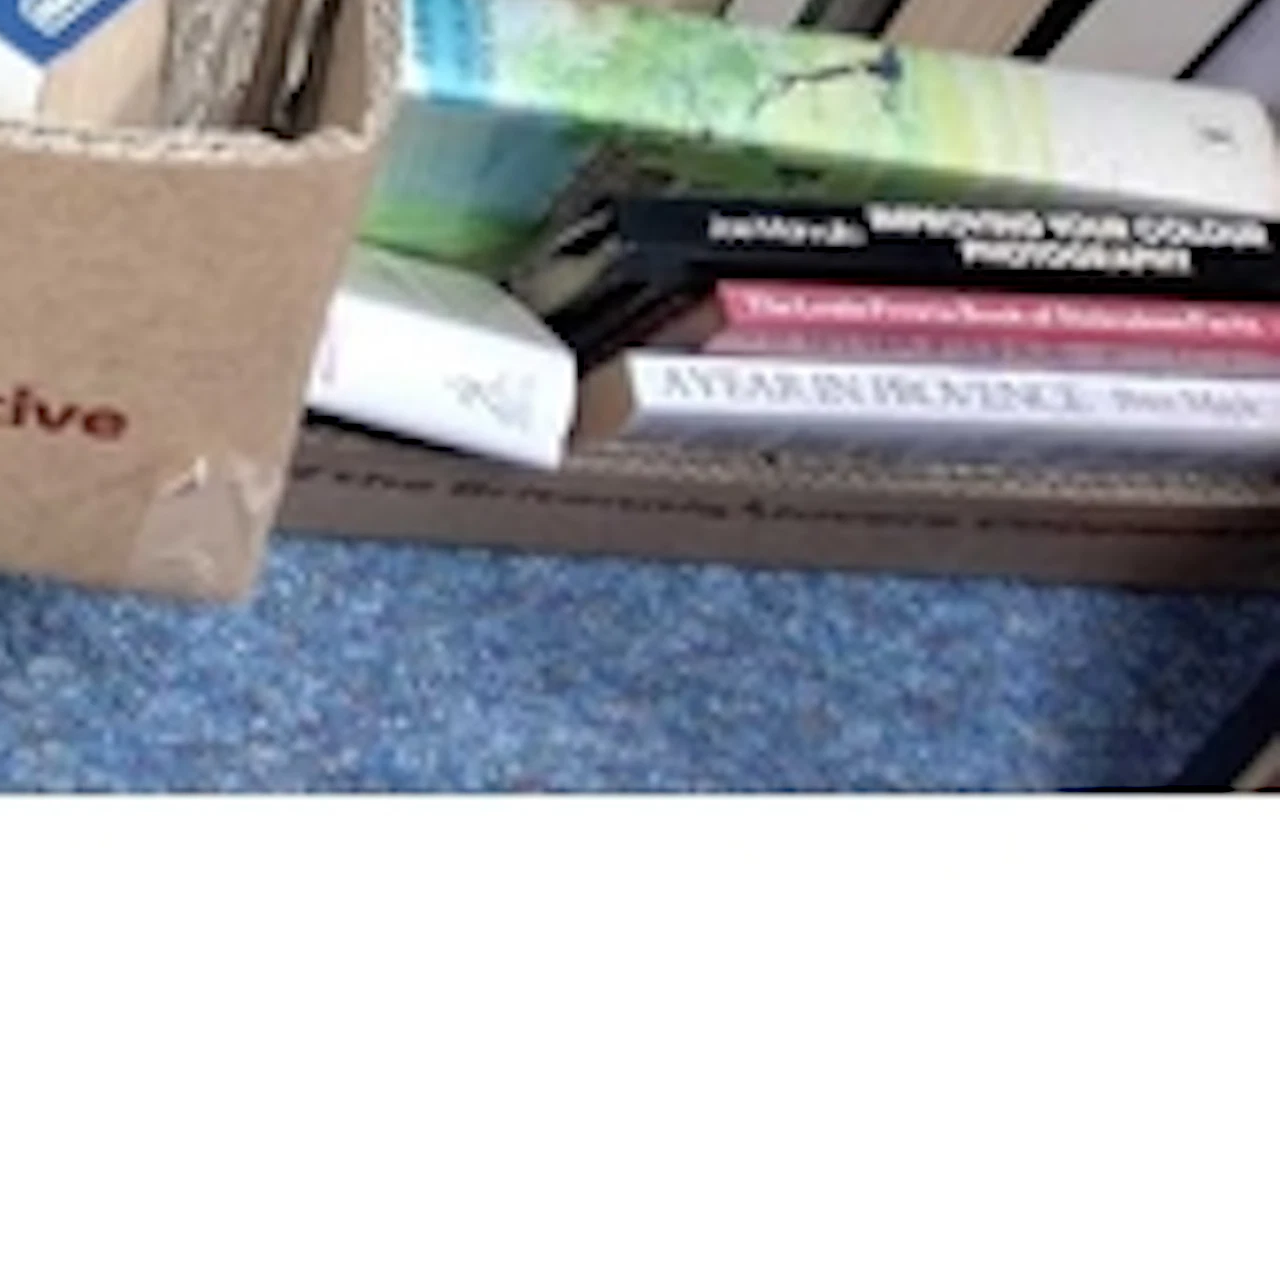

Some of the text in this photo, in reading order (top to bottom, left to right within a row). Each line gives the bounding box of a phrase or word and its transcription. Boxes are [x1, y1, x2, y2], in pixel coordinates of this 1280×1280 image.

[865, 202, 1043, 241] IMPROVING
[961, 239, 1192, 274] PHOTOGRAPHY
[691, 369, 804, 403] YEAR
[811, 374, 867, 405] IN
[872, 374, 1092, 415] PROVENCE
